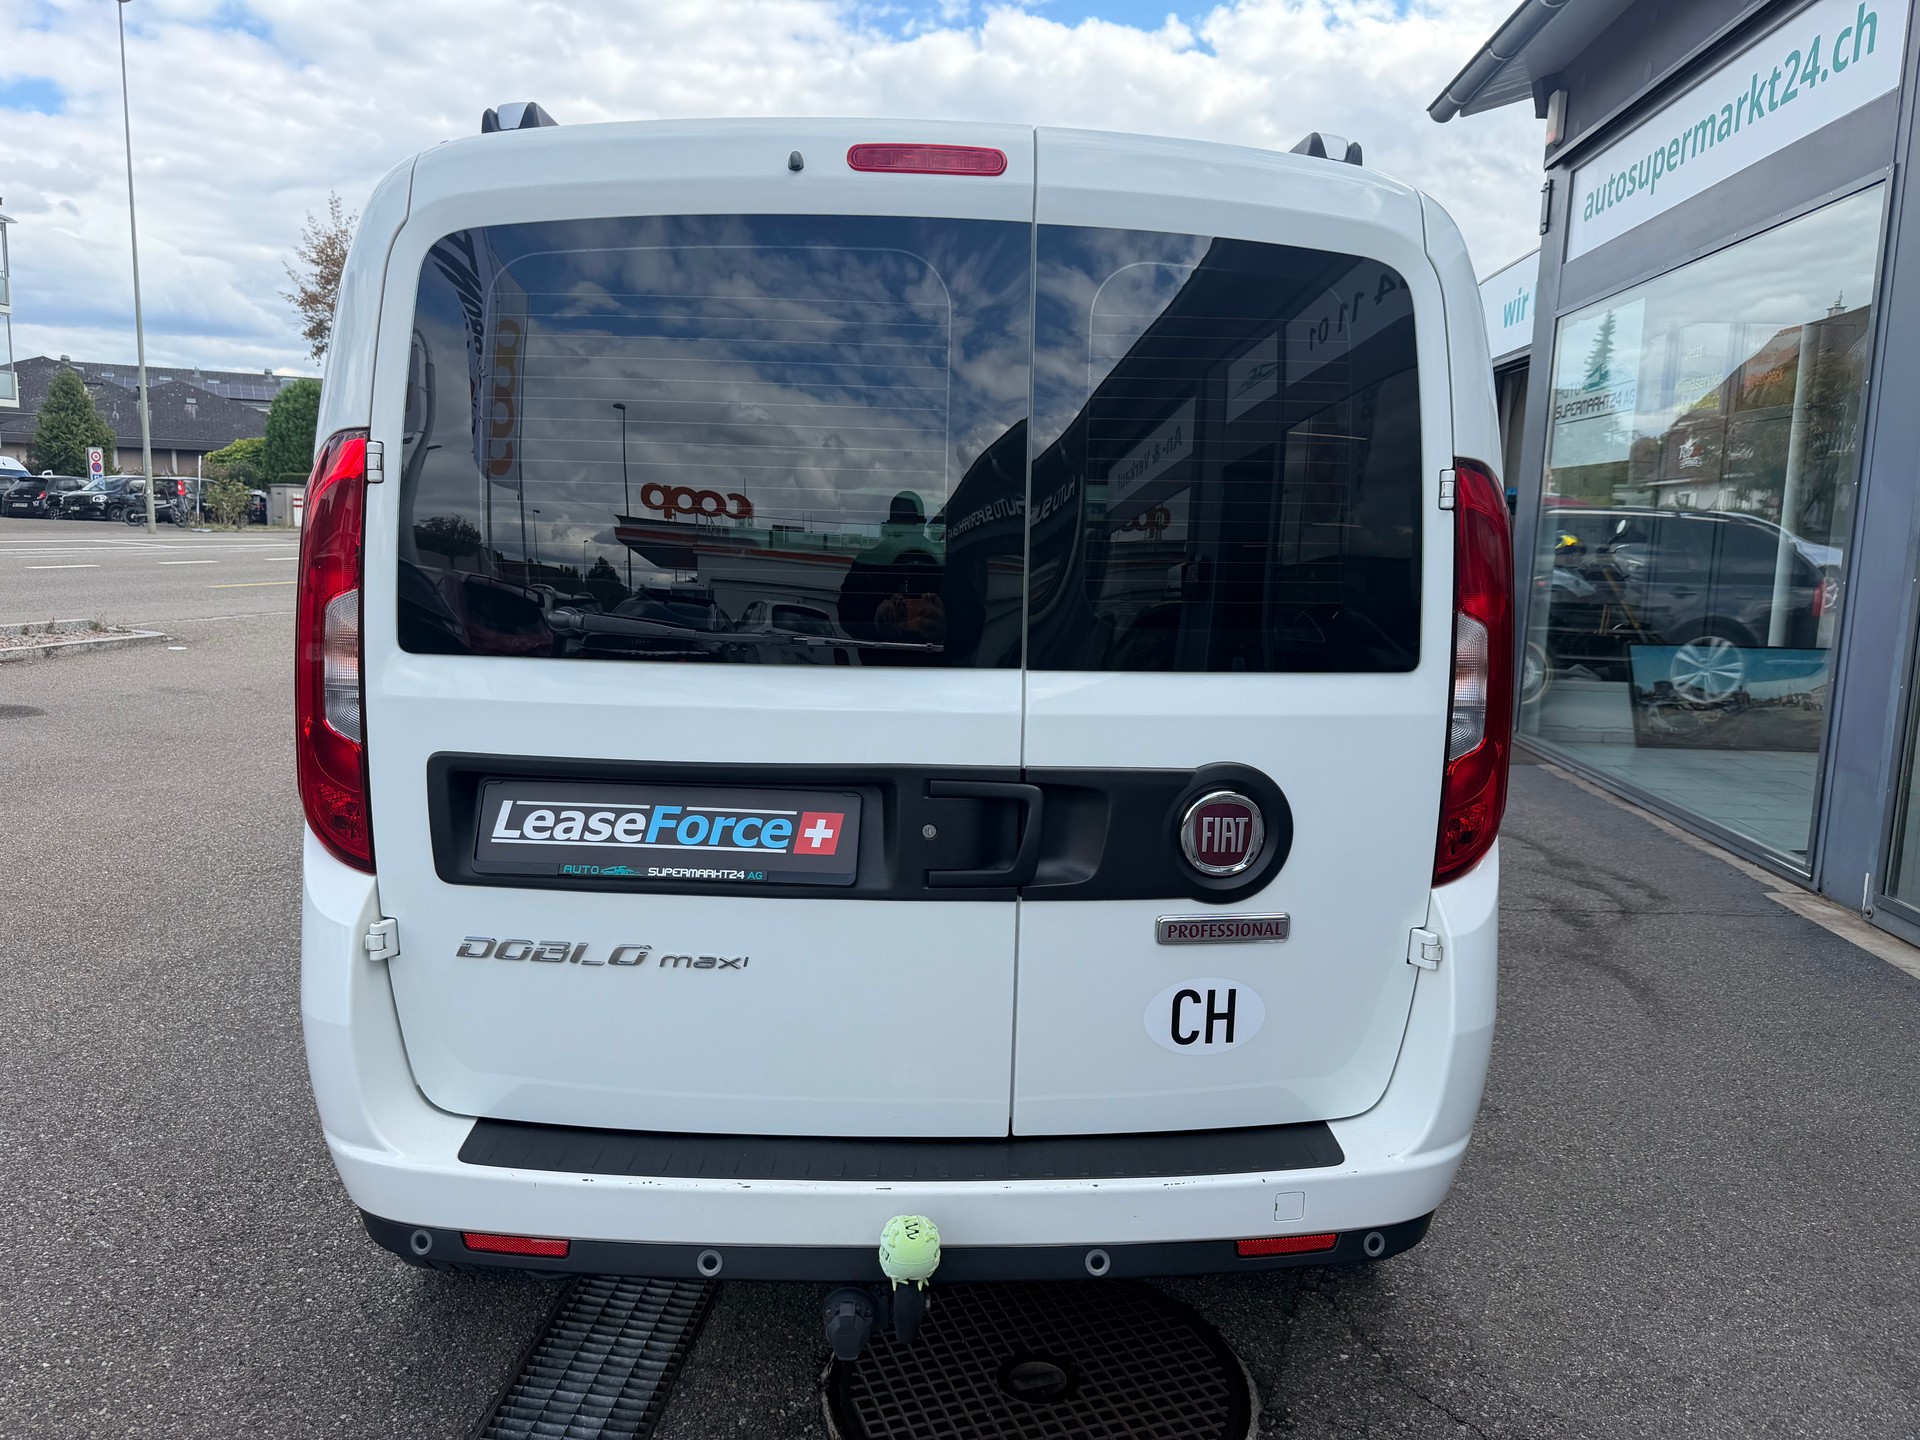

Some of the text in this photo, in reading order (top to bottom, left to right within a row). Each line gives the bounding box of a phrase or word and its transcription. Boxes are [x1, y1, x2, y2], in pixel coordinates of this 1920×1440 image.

[1583, 2, 1878, 223] autosupermarkt24.ch
[1503, 286, 1530, 329] wir
[491, 800, 793, 849] LeaseForce
[1202, 817, 1249, 853] FIAT
[563, 864, 763, 881] AUTO SUPERMARKT24 AG
[1167, 922, 1283, 940] PROFESSIONAL
[1170, 988, 1237, 1046] CH
